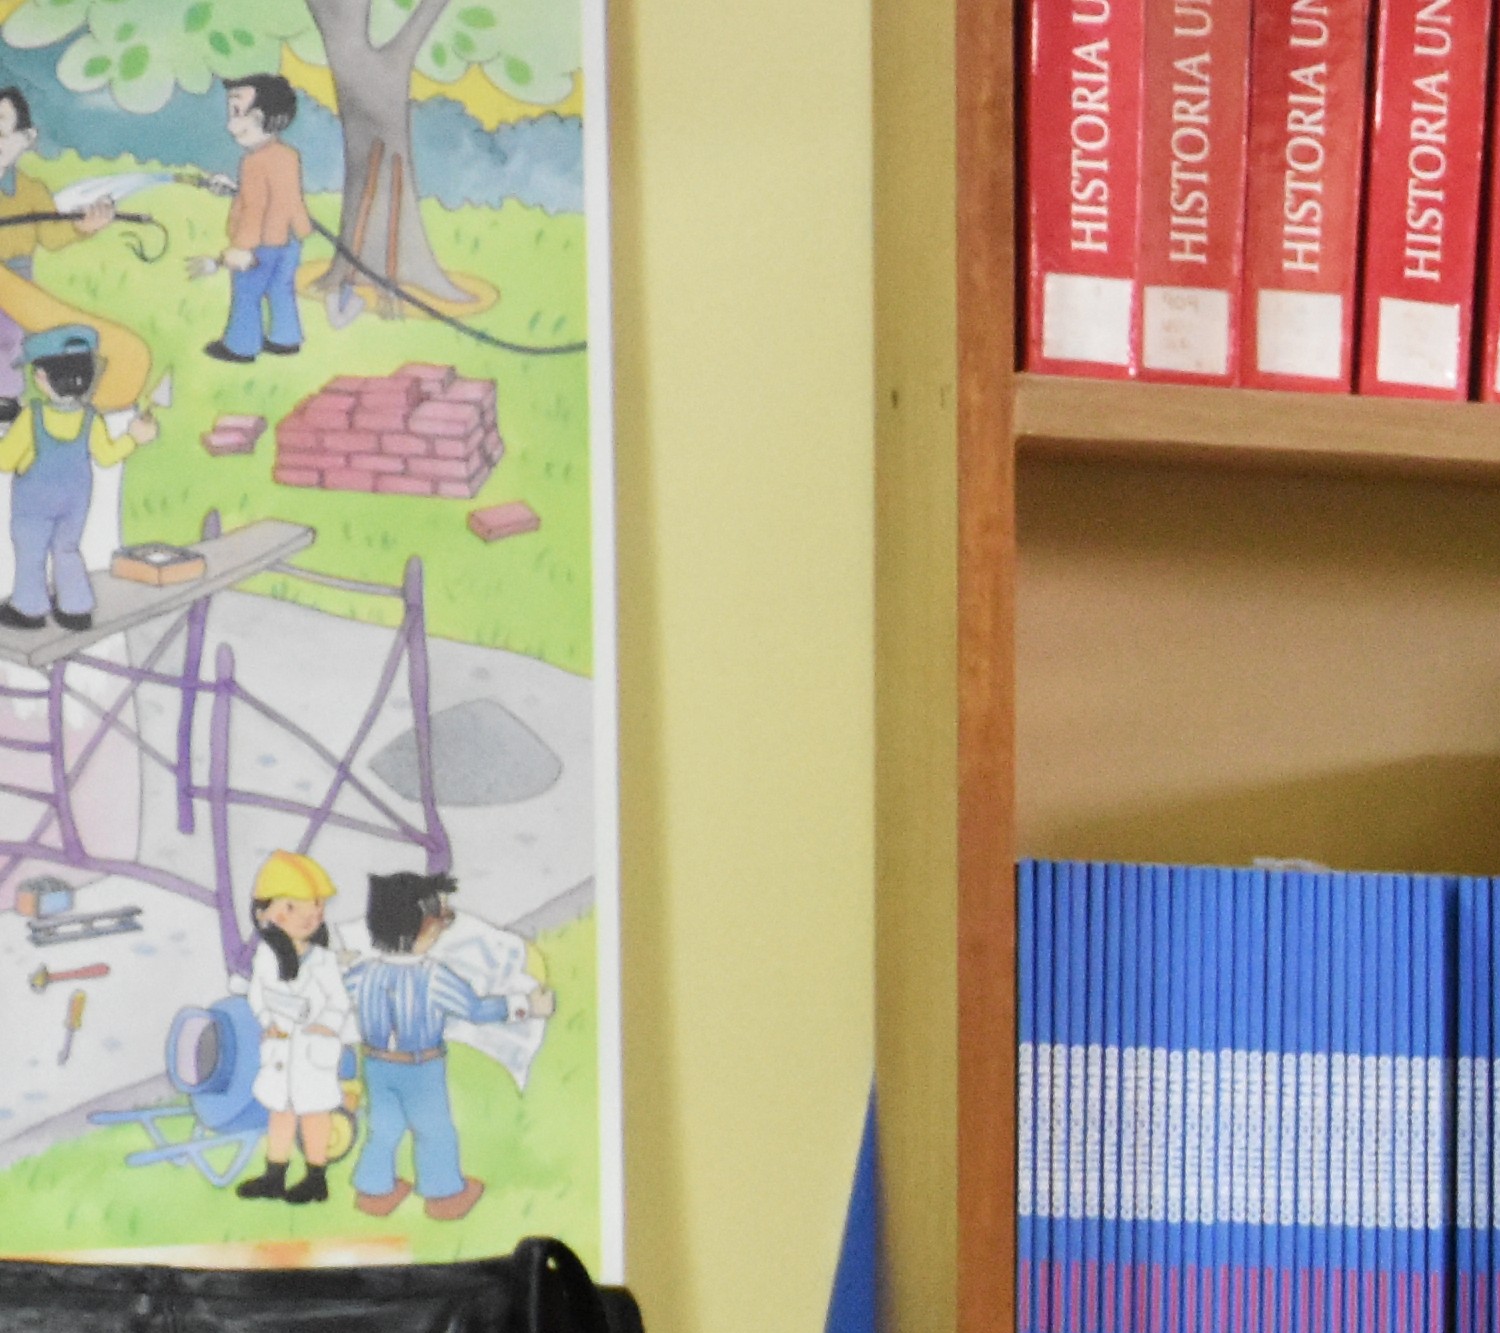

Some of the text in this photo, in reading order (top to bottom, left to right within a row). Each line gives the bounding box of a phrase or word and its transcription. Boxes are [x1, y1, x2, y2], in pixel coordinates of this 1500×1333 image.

[1067, 37, 1113, 251] HISTORIA
[1165, 50, 1216, 263] HISTORIA
[1278, 60, 1330, 271] HISTORIA
[1400, 68, 1454, 279] HISTORIA
